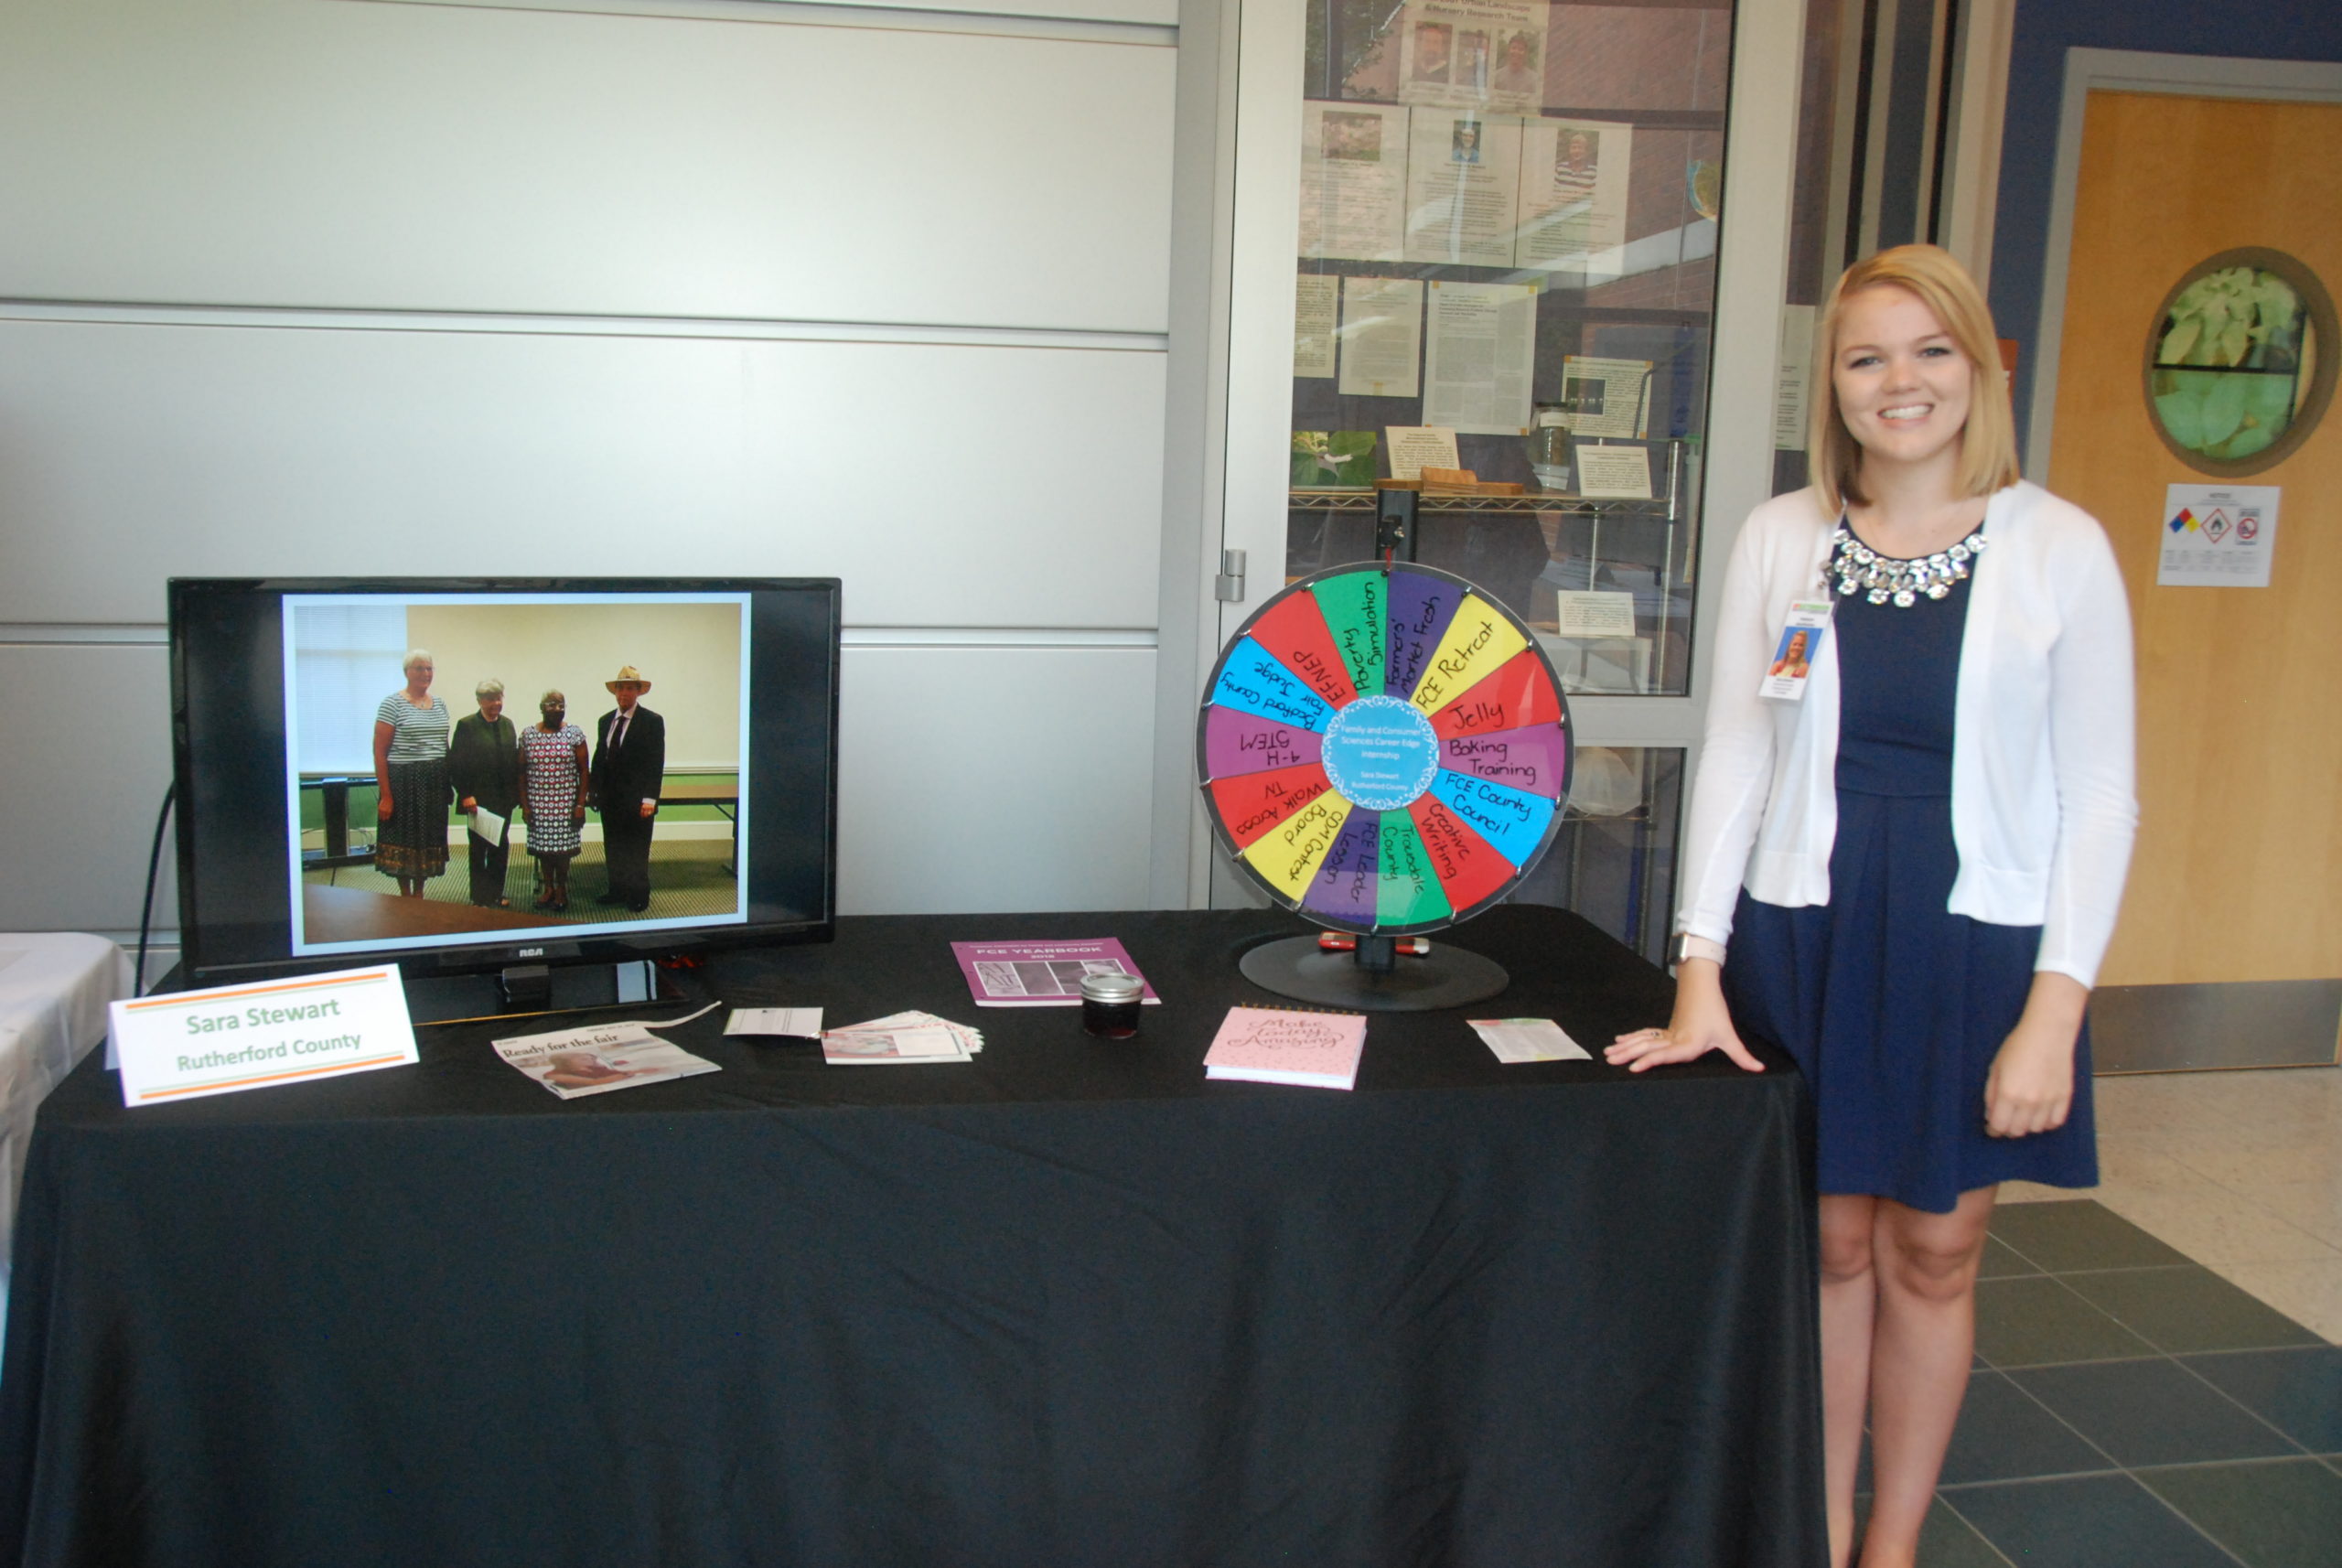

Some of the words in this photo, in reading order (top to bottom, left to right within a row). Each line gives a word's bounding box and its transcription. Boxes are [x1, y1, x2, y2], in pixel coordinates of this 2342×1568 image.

[1466, 7, 1504, 19] Research
[1507, 13, 1529, 22] Team
[1488, 0, 1531, 12] Landscape
[1361, 582, 1383, 666] Simulation
[1401, 640, 1423, 693] Market
[1413, 596, 1441, 636] Fresh
[1344, 628, 1371, 692] Poverty
[1415, 676, 1444, 710] FCE
[1437, 621, 1494, 681] Retreat
[1219, 671, 1261, 704] County
[1253, 661, 1295, 697] Judge
[1293, 650, 1346, 703] EFNEP
[1262, 698, 1317, 731] Bedford
[1300, 695, 1327, 716] Fair
[1449, 703, 1505, 729] Jelly
[1240, 730, 1290, 751] STEM
[1341, 725, 1365, 735] Family
[1367, 726, 1381, 735] and
[1382, 727, 1422, 736] Consumer
[1341, 736, 1373, 745] Sciences
[1375, 737, 1401, 746] Career
[1402, 739, 1421, 749] Edge
[1267, 750, 1301, 766] 4-H
[1361, 751, 1401, 761] Internship
[1449, 738, 1509, 762] Baking
[1351, 781, 1385, 789] Rutherford
[1386, 782, 1408, 791] County
[1360, 771, 1374, 779] Sara
[1375, 771, 1400, 779] Stewart
[1468, 758, 1537, 787] Training
[1263, 780, 1289, 800] TN
[1283, 782, 1325, 811] Walk
[1445, 773, 1475, 793] FCE
[1477, 785, 1532, 822] County
[1236, 807, 1280, 835] Across
[1284, 803, 1327, 848] Board
[1453, 793, 1511, 836] Council
[1361, 822, 1379, 849] FCE
[1429, 803, 1470, 862] Creative
[1289, 838, 1324, 882] Contest
[1325, 832, 1359, 885] Lesson
[1382, 826, 1400, 881] County
[1422, 817, 1457, 880] Writing
[1350, 854, 1375, 904] Leader
[519, 948, 543, 958] RCA
[1011, 946, 1102, 956] YEARBOOK
[187, 1013, 241, 1036] Sara
[247, 998, 341, 1027] Stewart
[177, 1041, 288, 1071] Rutherford
[293, 1033, 362, 1056] County
[503, 1047, 546, 1058] Ready
[548, 1041, 568, 1051] for
[570, 1037, 593, 1047] the
[595, 1034, 619, 1045] fair
